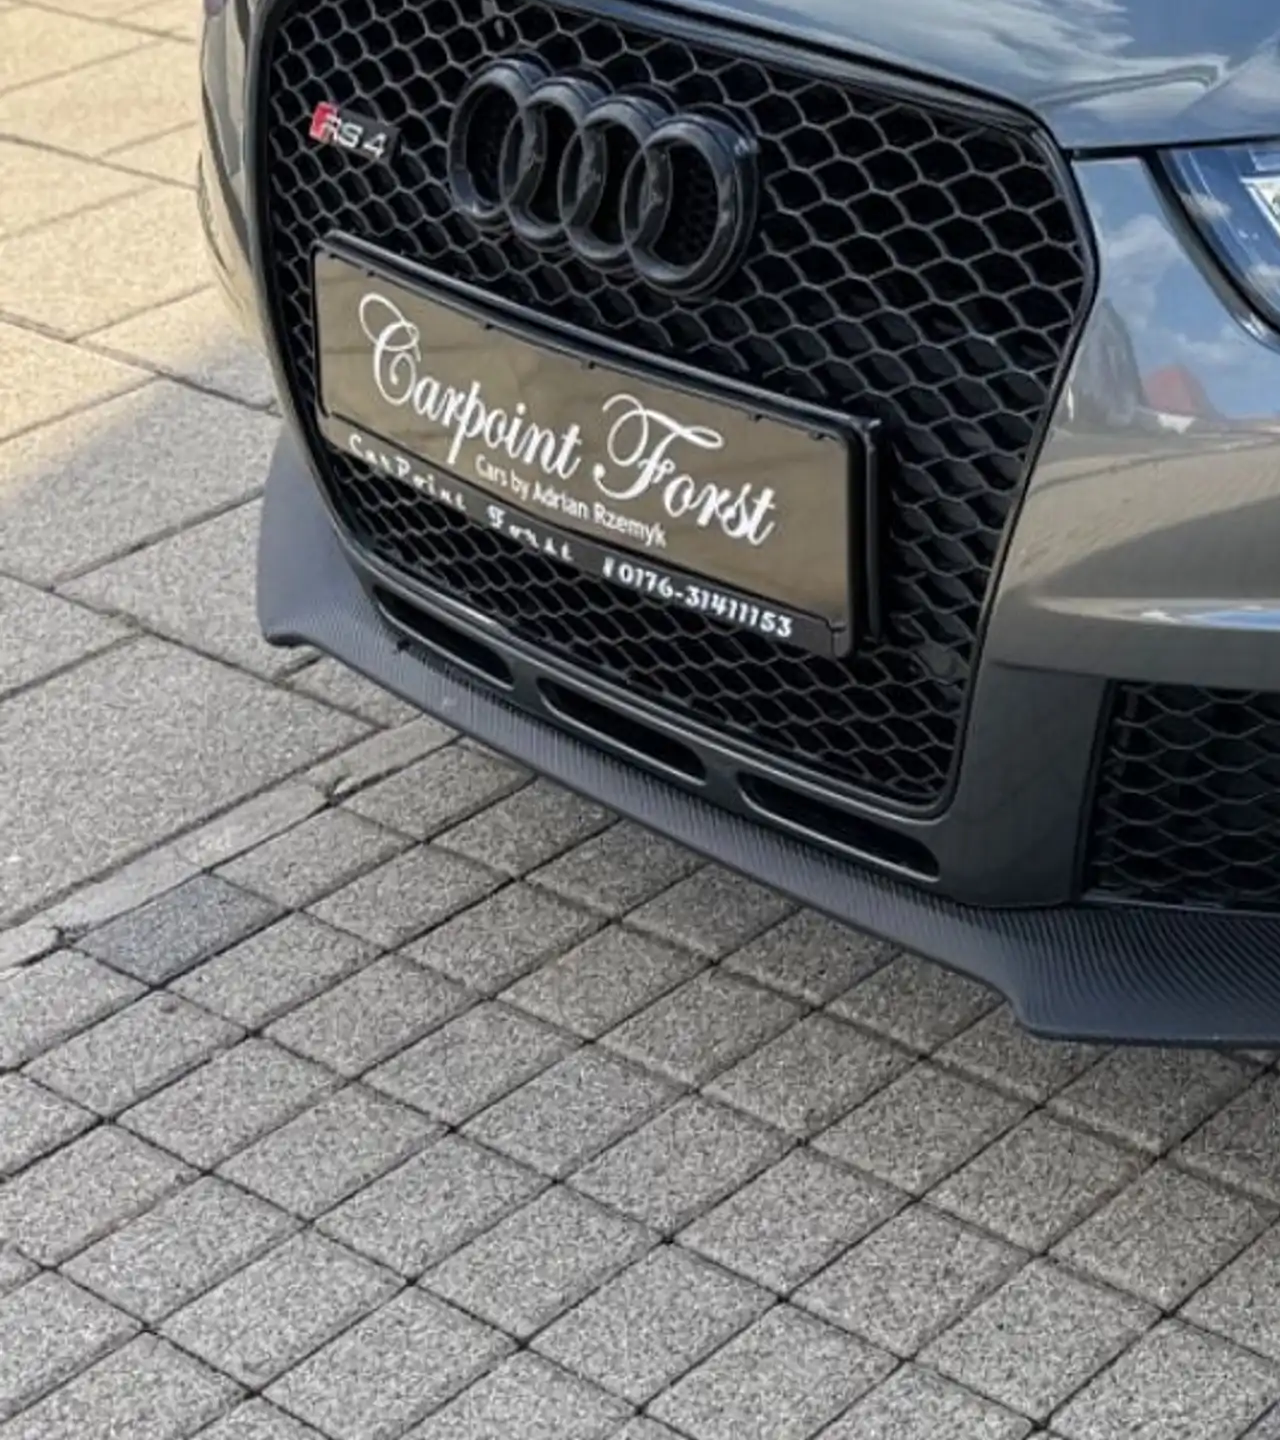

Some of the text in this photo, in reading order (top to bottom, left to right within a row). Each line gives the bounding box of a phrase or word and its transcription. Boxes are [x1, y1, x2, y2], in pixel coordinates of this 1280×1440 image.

[359, 293, 776, 545] Carpoint Forst
[475, 454, 667, 547] Cars by Adrian Rzemyk
